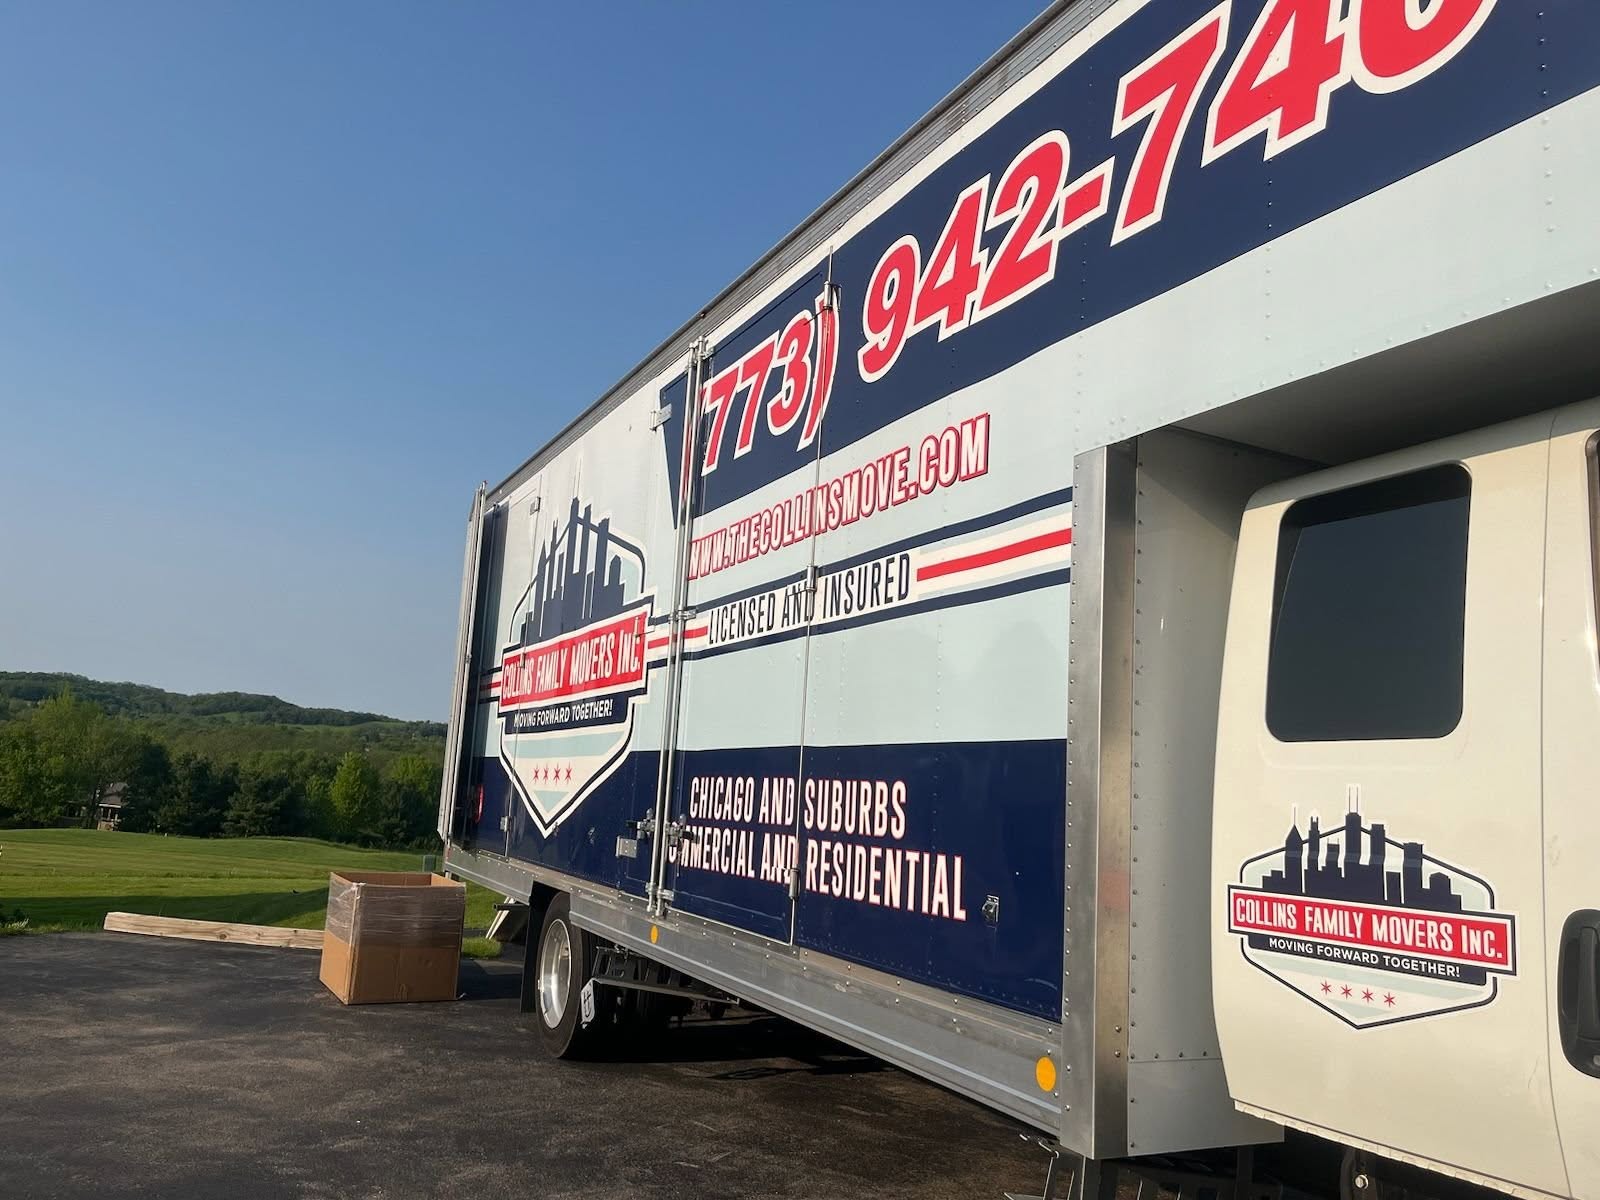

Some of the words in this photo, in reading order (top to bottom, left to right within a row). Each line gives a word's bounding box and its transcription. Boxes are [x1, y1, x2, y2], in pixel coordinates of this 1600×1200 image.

[688, 413, 990, 580] WWW.THECOLLINSMOVE.COM
[709, 593, 775, 644] LICENSED
[781, 581, 815, 627] AND
[823, 553, 910, 619] INSURED
[503, 657, 533, 699] COLLINS
[535, 648, 569, 693] FAMILY
[570, 633, 616, 686] MOVERS
[514, 711, 536, 728] MOVING
[537, 707, 570, 727] FORWARD
[572, 699, 612, 720] TOGETHER!
[689, 776, 754, 823] CHICAGO
[759, 777, 796, 825] AND
[804, 779, 907, 839] SUBURBS
[668, 822, 756, 878] OMMERCIAL
[760, 832, 798, 886] AND
[806, 838, 967, 922] RESIDENTIAL
[1234, 897, 1297, 931] COLLINS
[1304, 905, 1363, 939] FAMILY
[1372, 914, 1453, 951] MOVERS
[1269, 937, 1314, 954] MOVING
[1317, 945, 1379, 965] FORWARD
[1383, 954, 1460, 978] TOGETHER!
